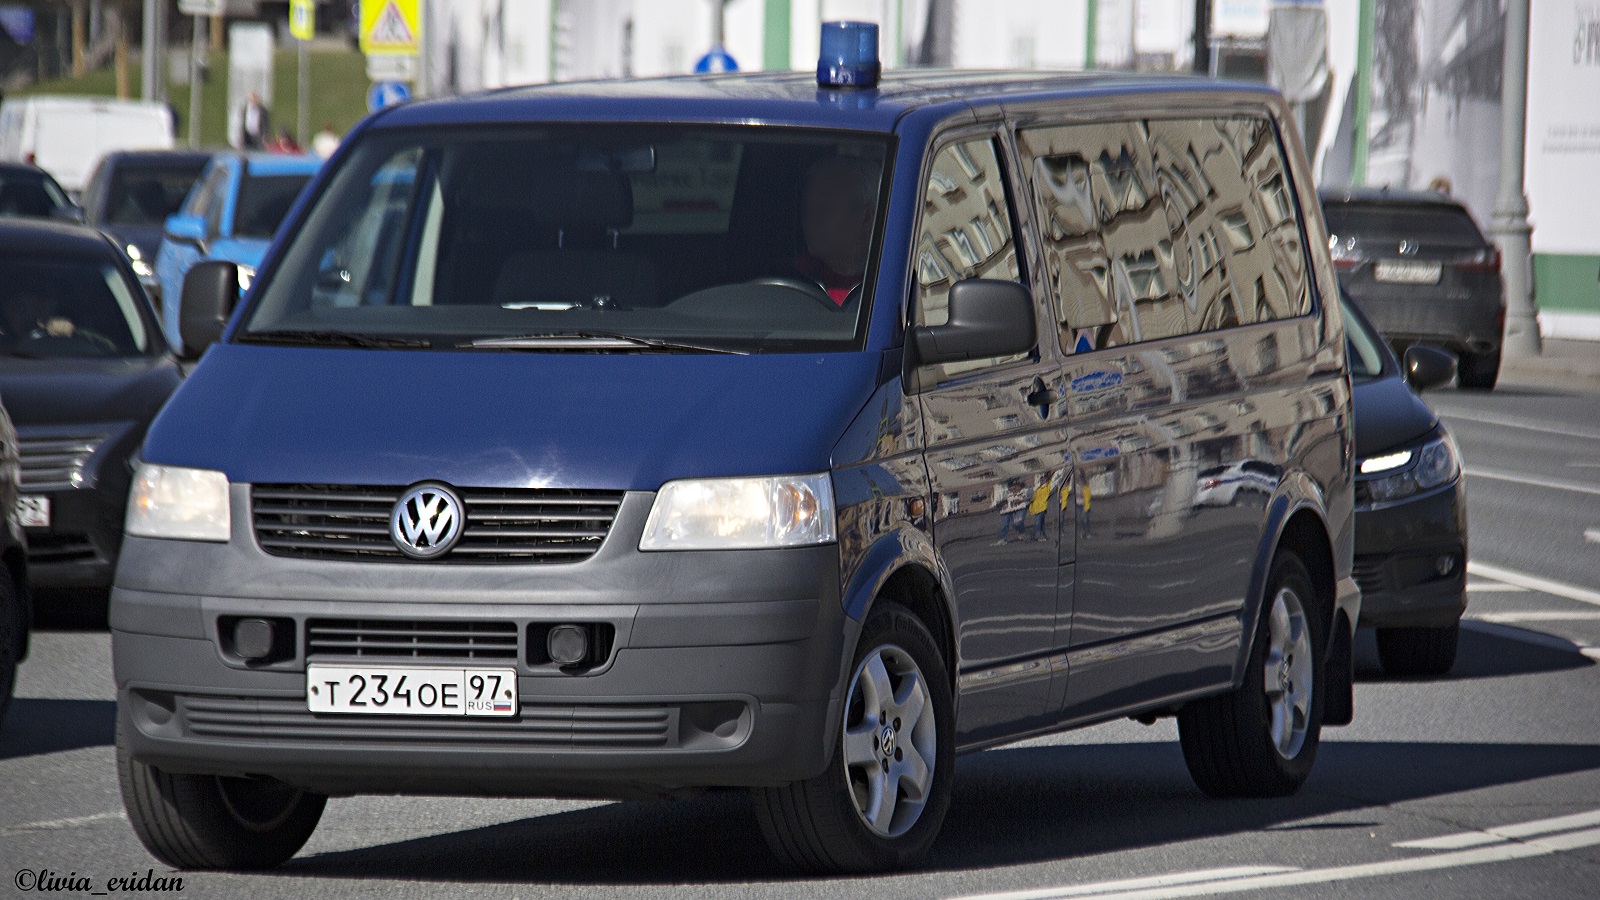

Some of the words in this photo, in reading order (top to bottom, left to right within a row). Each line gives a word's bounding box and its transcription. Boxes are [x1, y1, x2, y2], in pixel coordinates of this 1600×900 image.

[397, 490, 456, 551] VW
[469, 675, 502, 701] 97
[468, 701, 493, 711] RUS
